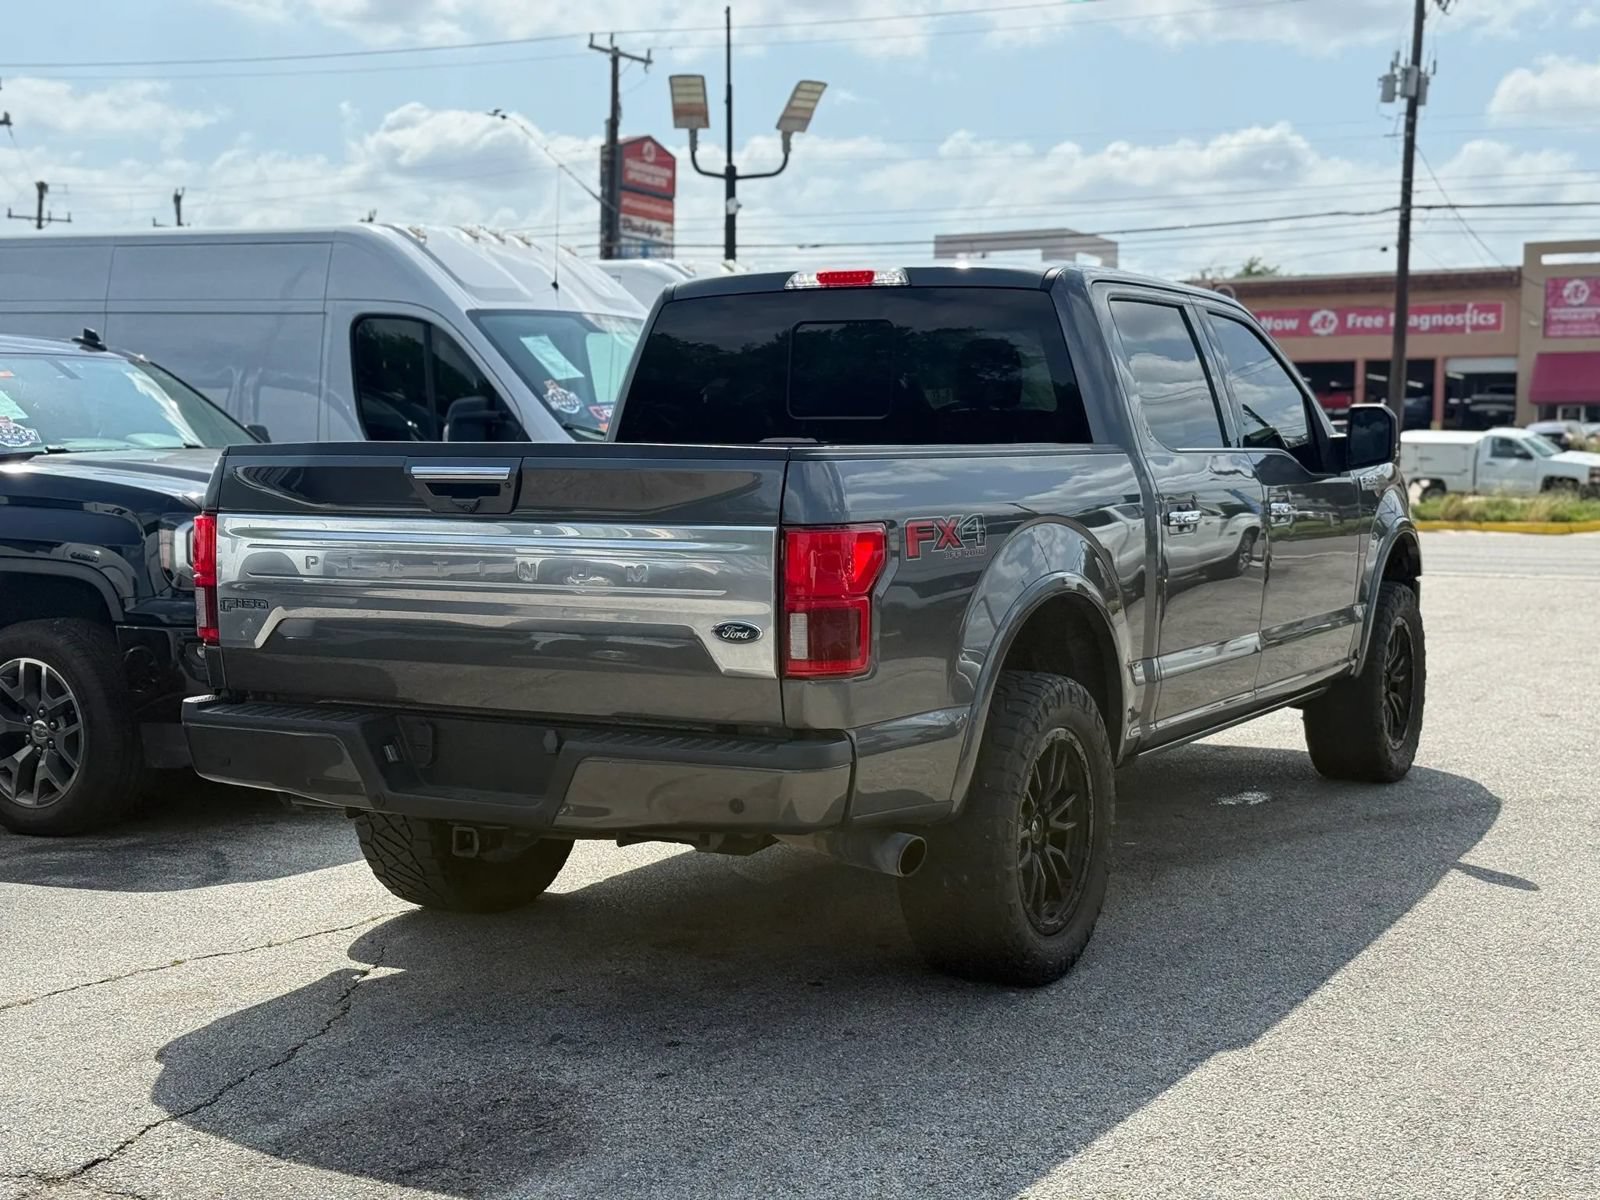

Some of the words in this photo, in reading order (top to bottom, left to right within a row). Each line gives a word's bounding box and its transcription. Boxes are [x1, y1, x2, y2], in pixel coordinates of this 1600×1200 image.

[1260, 315, 1299, 331] Now
[1346, 313, 1385, 329] Free
[1389, 303, 1497, 334] agnostics
[904, 513, 986, 561] FX4
[721, 624, 751, 640] Ford
